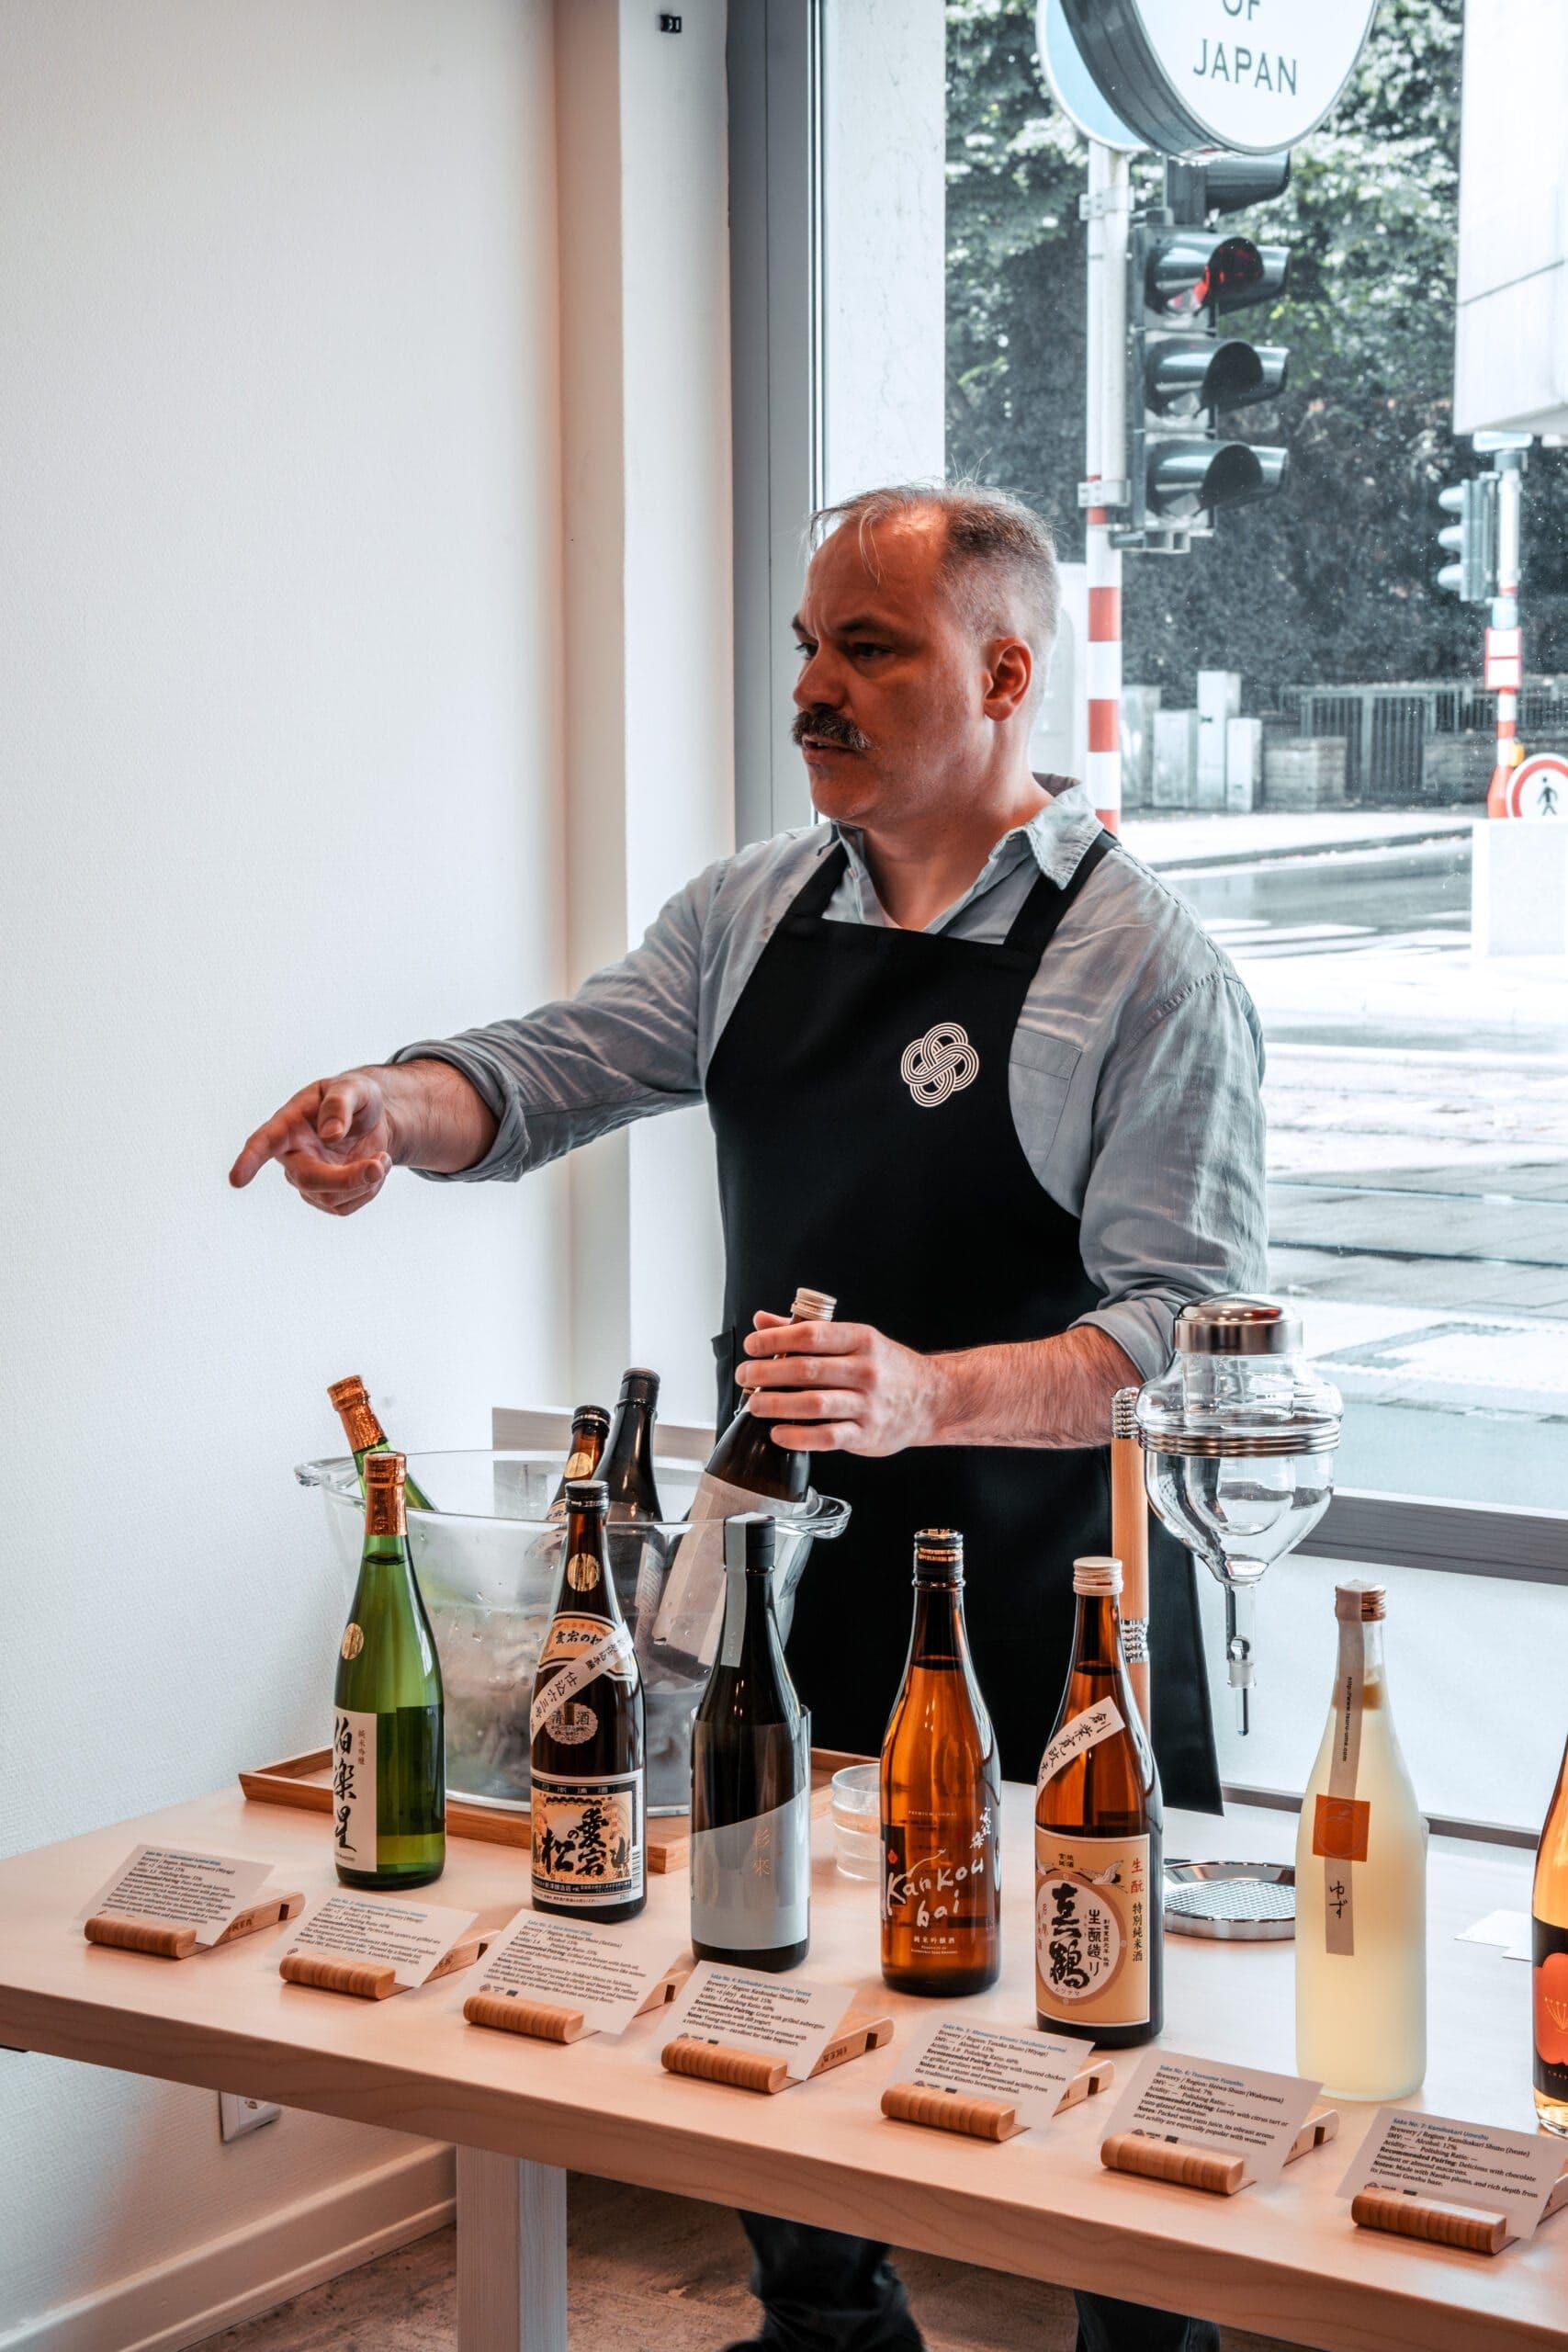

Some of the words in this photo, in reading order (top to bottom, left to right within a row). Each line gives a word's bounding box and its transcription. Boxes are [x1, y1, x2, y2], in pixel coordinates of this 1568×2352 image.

[1193, 39, 1296, 96] JAPAN
[917, 1889, 959, 1928] bai
[1132, 1902, 1144, 1962] 特別純米酒
[1145, 2092, 1191, 2106] Recommended
[1246, 2092, 1284, 2104] (Wakayama)
[1377, 2154, 1402, 2163] fondant
[1380, 2147, 1430, 2161] Recommended
[1459, 2163, 1488, 2172] Delicious
[1506, 2172, 1537, 2181] chocolate
